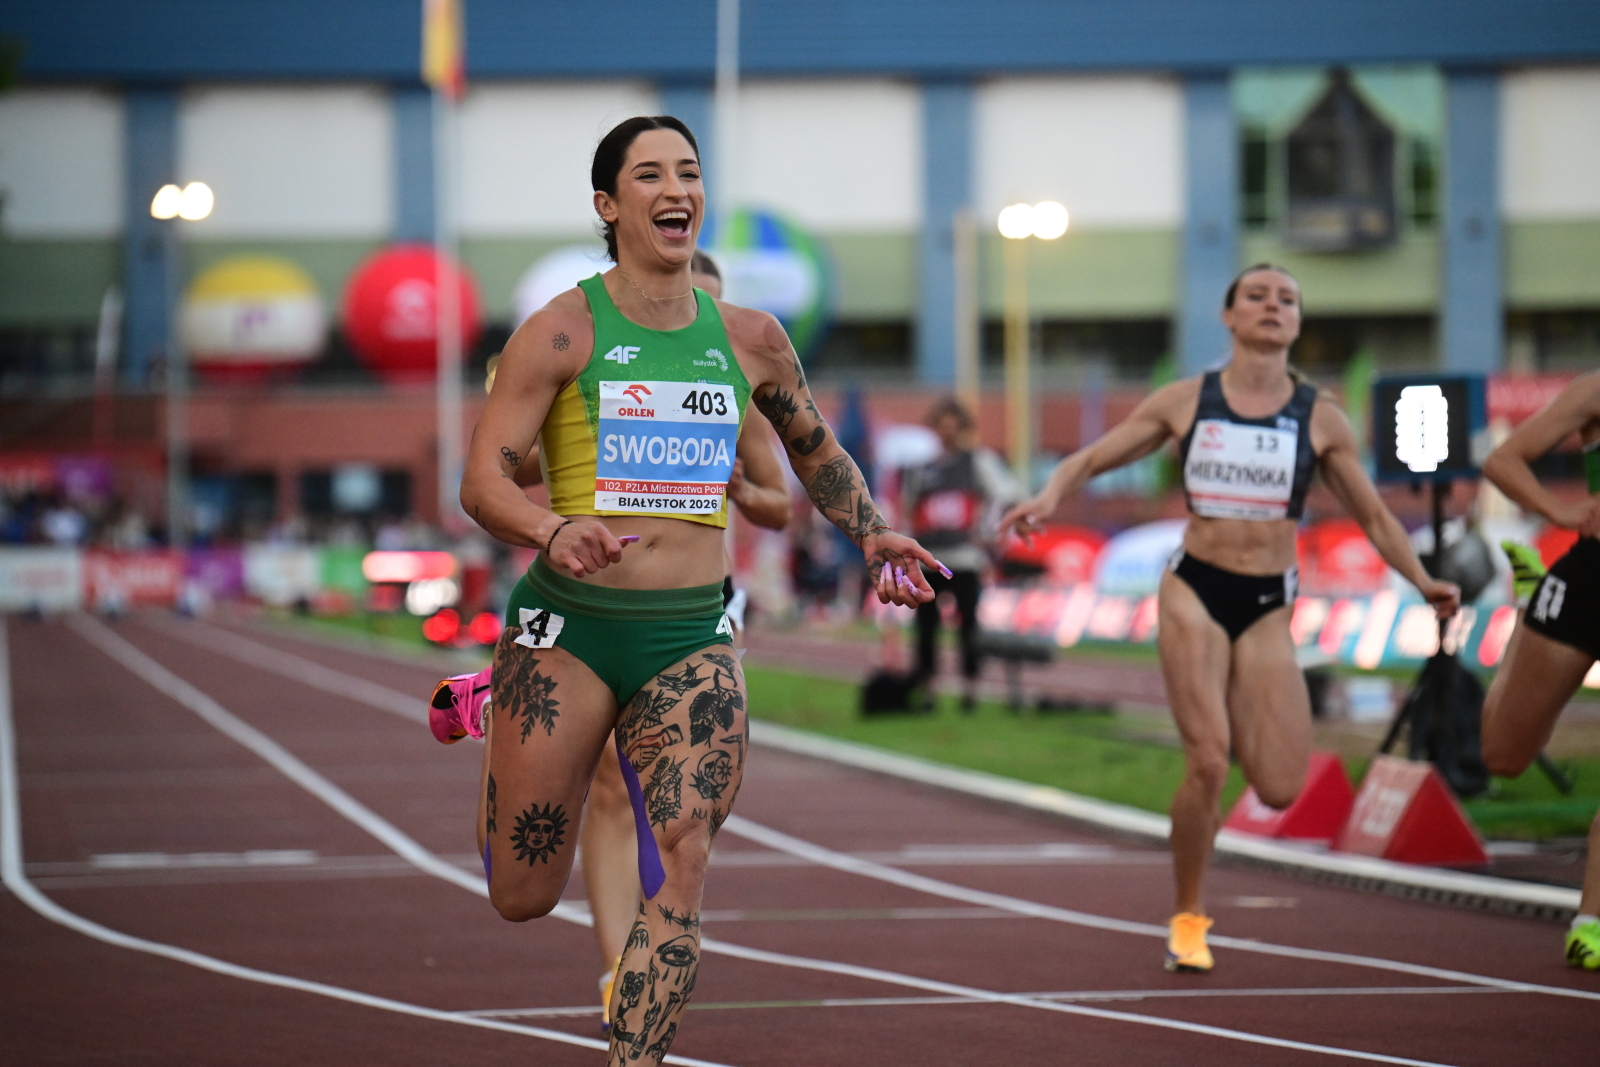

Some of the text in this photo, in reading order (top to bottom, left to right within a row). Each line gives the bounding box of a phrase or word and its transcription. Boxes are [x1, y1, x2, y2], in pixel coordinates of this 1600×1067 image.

[604, 345, 641, 365] 4F
[692, 359, 718, 367] Białystok
[681, 390, 728, 416] 403
[618, 407, 655, 418] ORLEN
[603, 433, 731, 467] SWOBODA
[604, 481, 623, 491] 102.
[625, 483, 649, 492] PZLA
[650, 483, 703, 494] Mistrzostwa
[618, 497, 717, 509] BIAŁYSTOK 2026
[527, 609, 551, 646] 4
